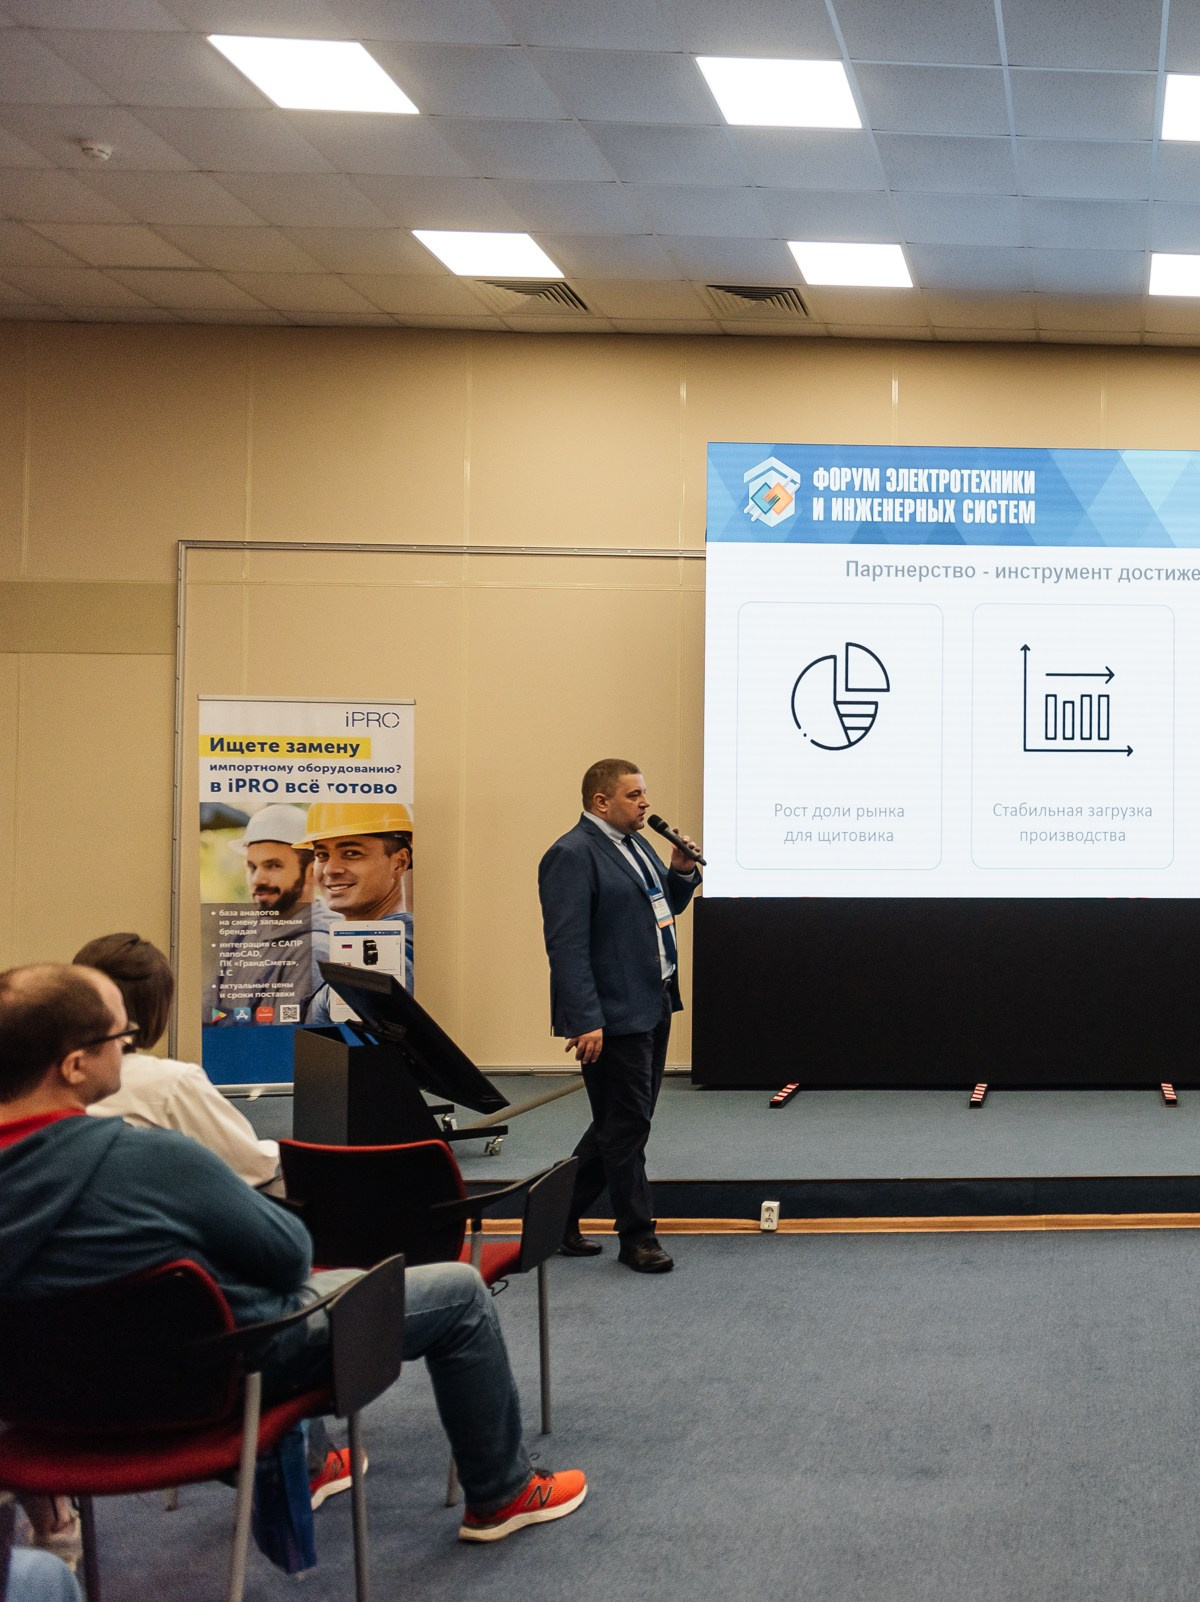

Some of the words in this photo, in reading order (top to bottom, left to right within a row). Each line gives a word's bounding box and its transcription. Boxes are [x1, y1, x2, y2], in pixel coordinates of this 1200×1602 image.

[812, 467, 880, 492] ФОРУМ
[885, 469, 1036, 494] ЭЛЕКТРОТЕХНИКИ
[812, 497, 824, 521] И
[831, 498, 956, 524] ИНЖЕНЕРНЫХ
[962, 500, 1036, 525] СИСТЕМ
[846, 560, 976, 582] Партнерство
[995, 564, 1112, 584] инструмент
[345, 711, 400, 728] iPRO
[210, 737, 280, 754] Ищете
[286, 740, 360, 758] замену
[210, 764, 294, 774] импортному
[298, 763, 402, 775] оборудованию?
[210, 781, 222, 792] в
[228, 778, 279, 793] iPRO
[285, 779, 320, 794] всё
[774, 804, 808, 818] Рост
[812, 806, 850, 820] доли
[856, 806, 905, 820] рынка
[992, 802, 1084, 818] Стабильная
[1088, 804, 1152, 820] загрузка
[784, 830, 812, 844] для
[818, 830, 894, 844] щитовика
[1020, 830, 1126, 845] производства
[526, 1484, 552, 1507] N
